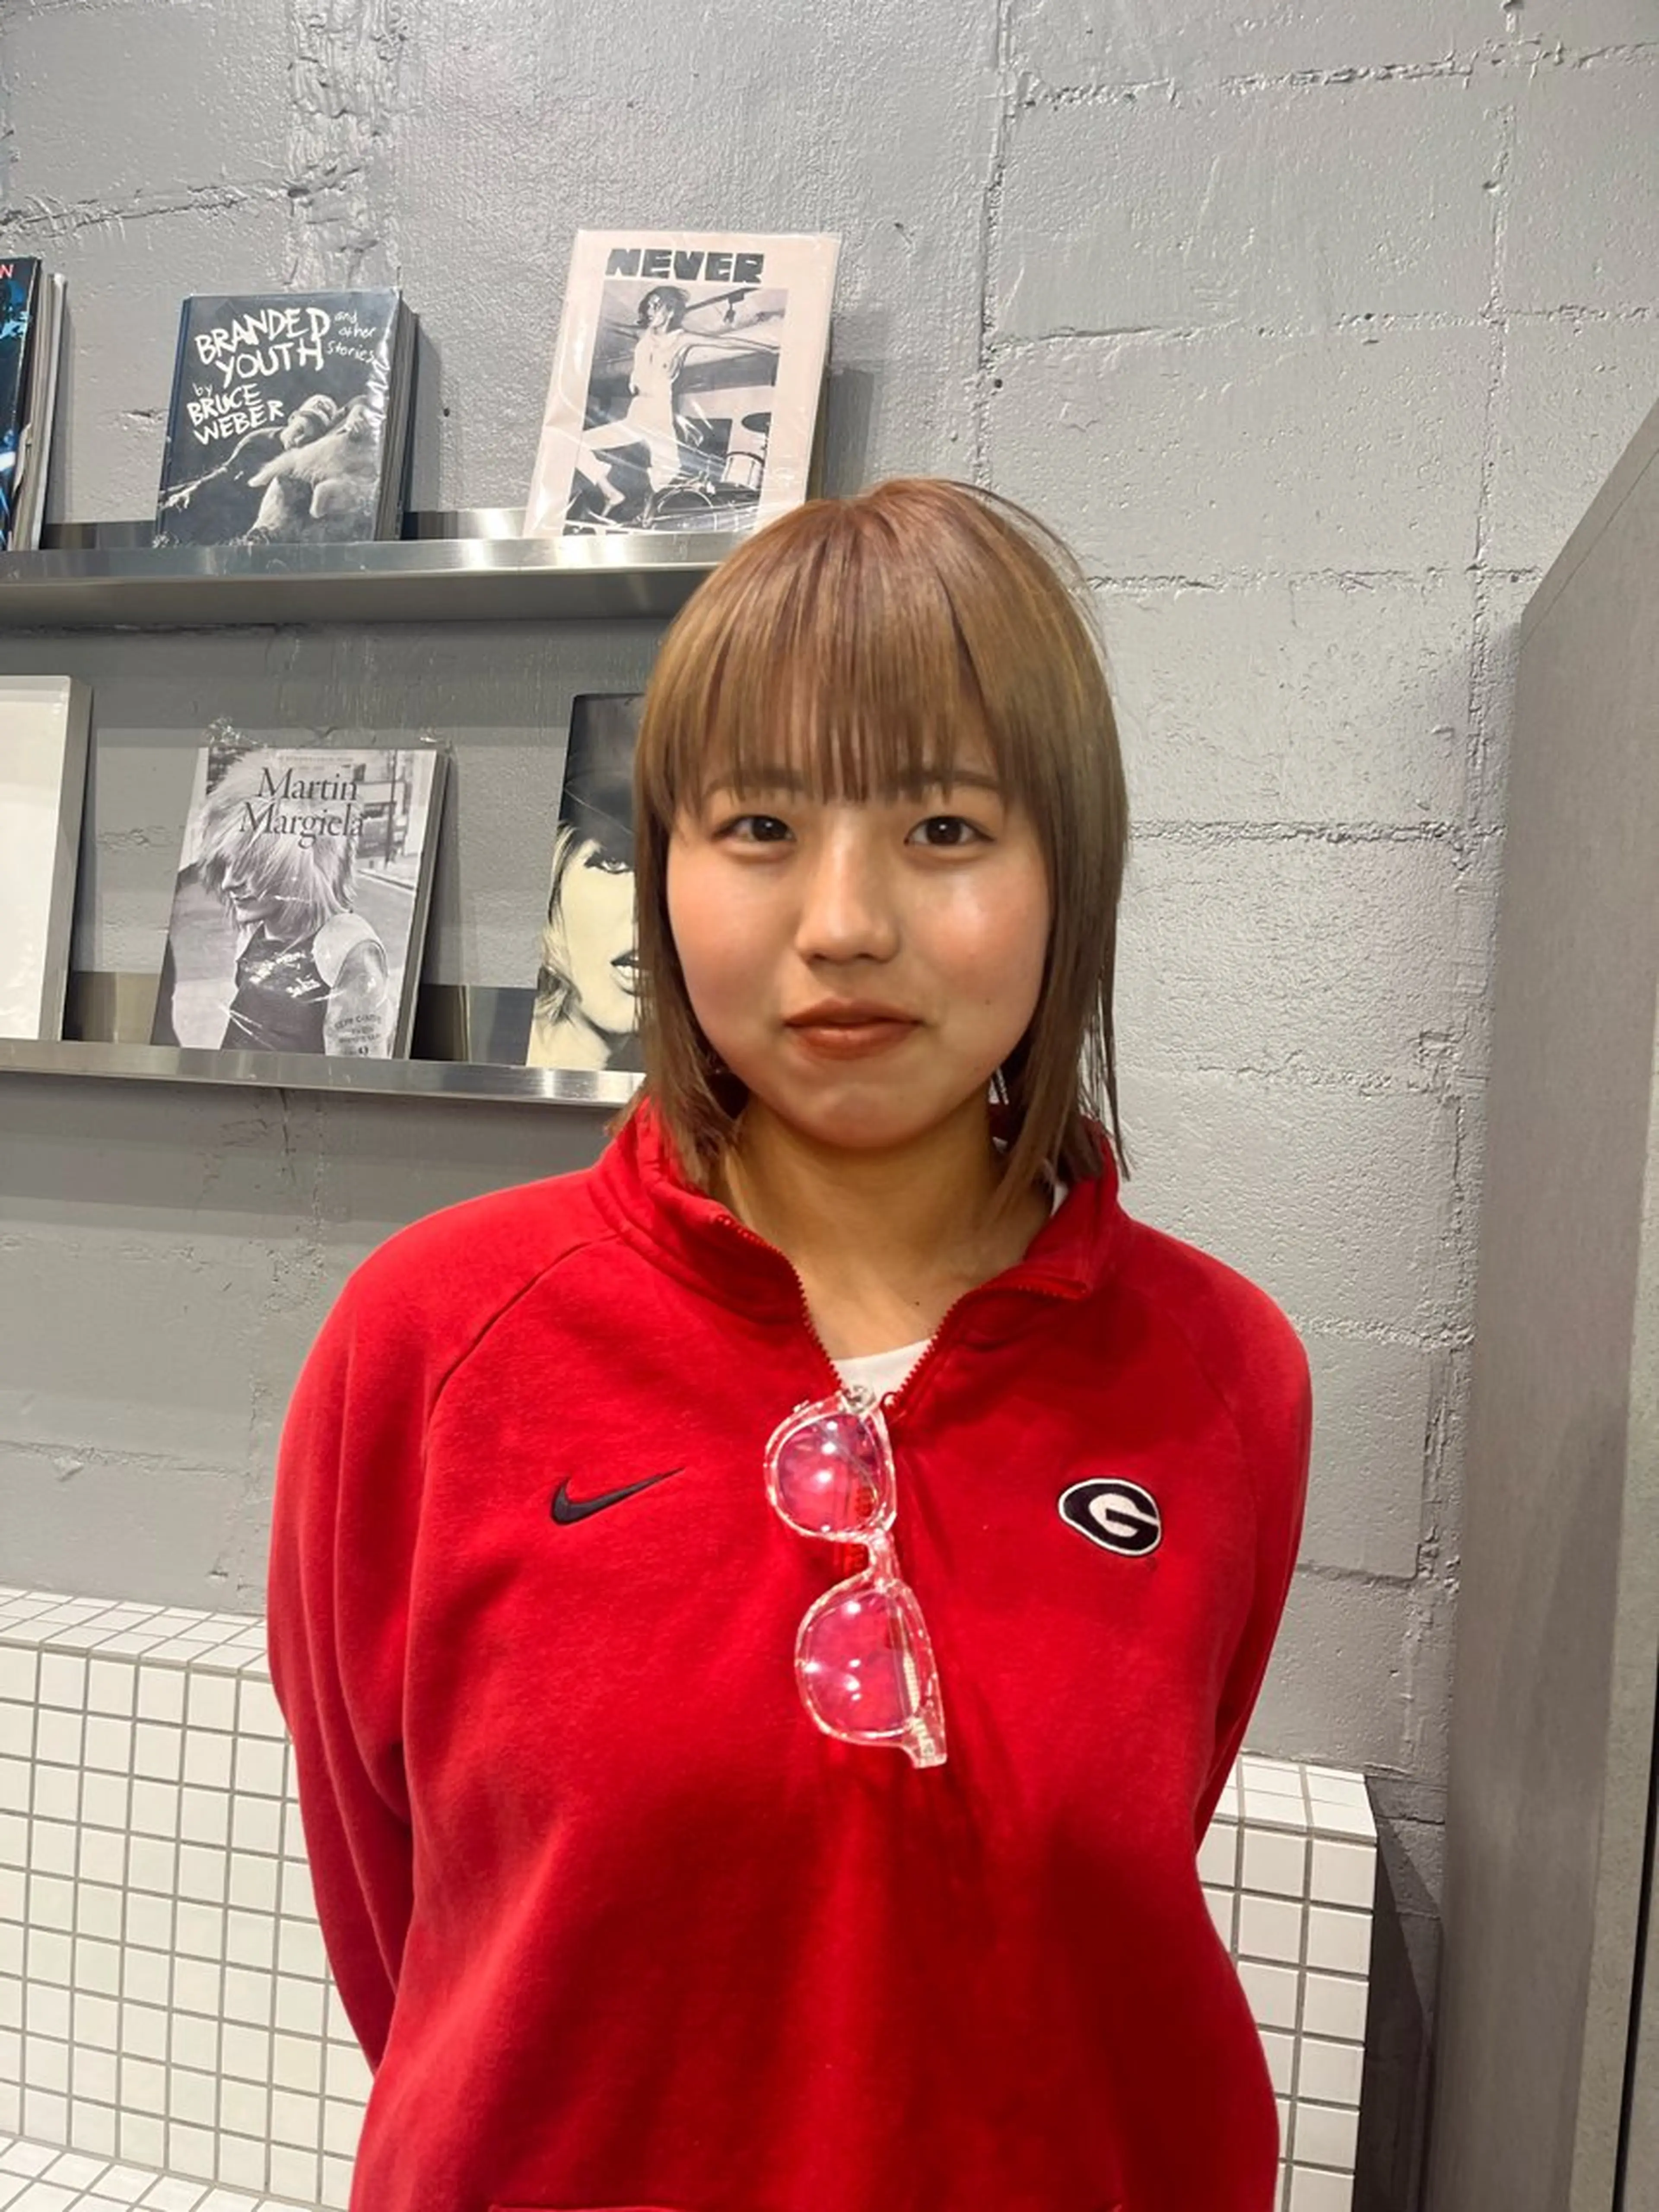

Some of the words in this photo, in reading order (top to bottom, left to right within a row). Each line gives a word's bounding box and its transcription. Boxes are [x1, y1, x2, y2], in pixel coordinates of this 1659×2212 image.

[605, 248, 764, 283] NEVER
[194, 307, 331, 365] BRANDED
[334, 309, 358, 324] and
[338, 323, 377, 339] other
[215, 337, 324, 389] YOUTH
[187, 383, 262, 426] BRUCE
[192, 382, 213, 398] by
[193, 400, 284, 445] WEBER
[255, 766, 358, 801] Martin
[239, 801, 364, 849] Margiela
[1058, 1479, 1161, 1555] G
